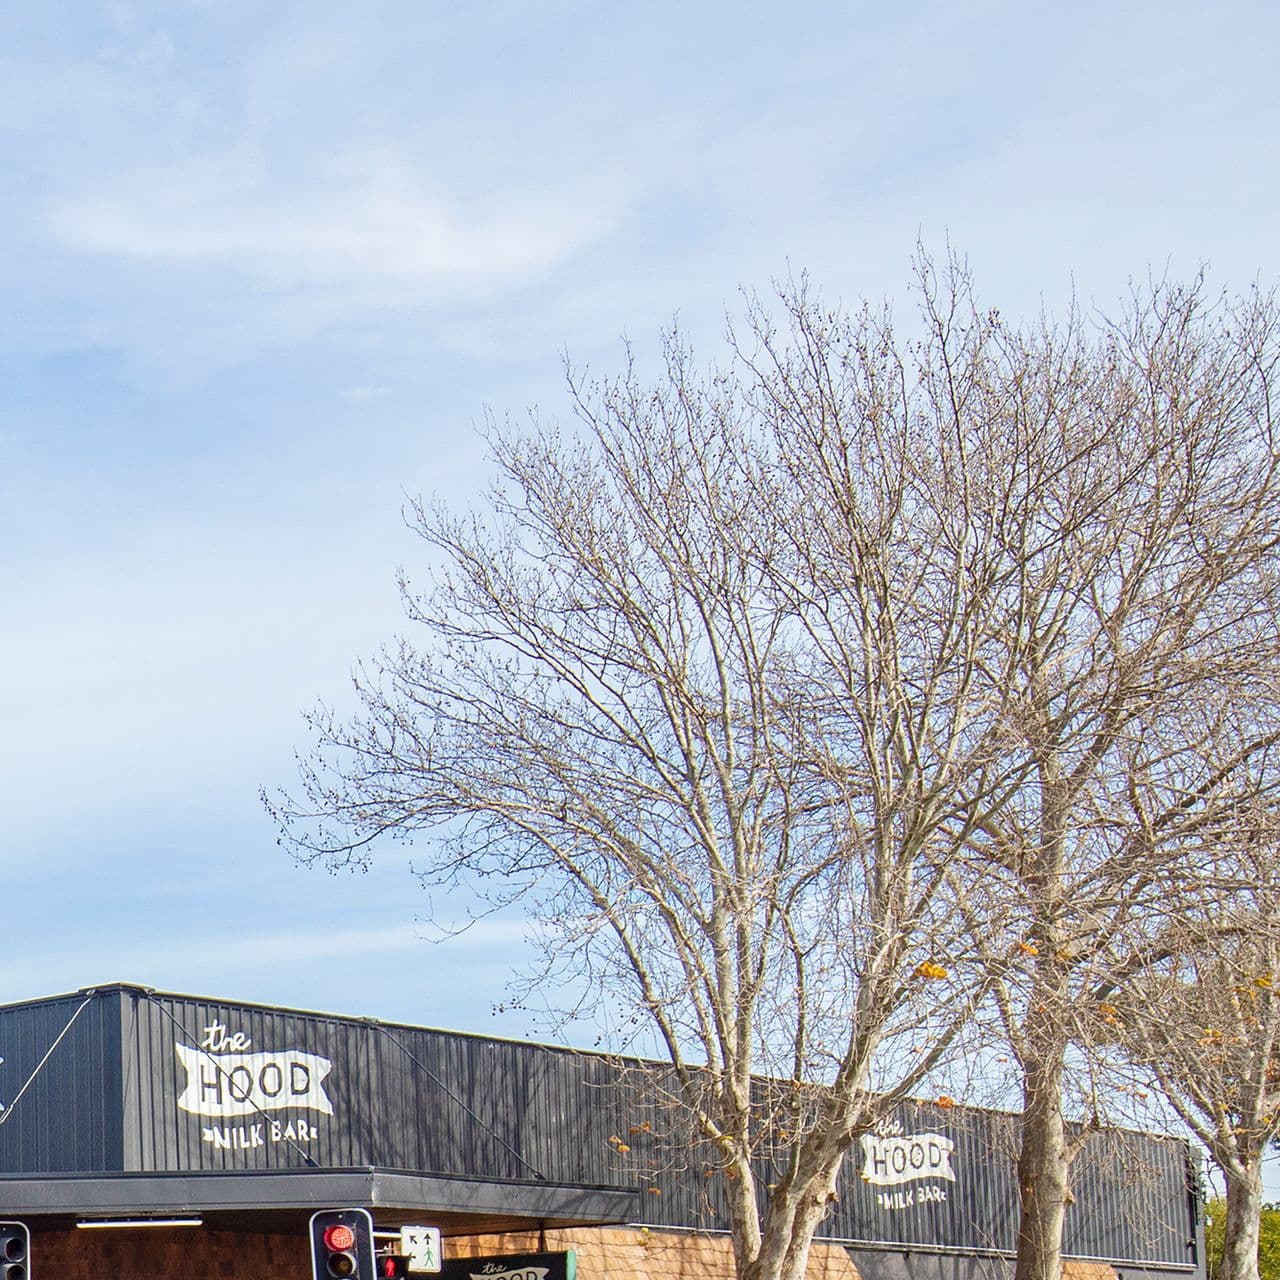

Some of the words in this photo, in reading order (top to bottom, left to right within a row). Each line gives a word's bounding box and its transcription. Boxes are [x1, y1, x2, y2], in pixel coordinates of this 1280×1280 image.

[201, 1018, 252, 1052] the
[200, 1061, 311, 1105] HOOD
[271, 1119, 310, 1142] BAR
[872, 1141, 942, 1176] HOOD
[883, 1189, 914, 1210] MILK
[917, 1185, 942, 1203] BAR
[482, 1261, 508, 1274] the
